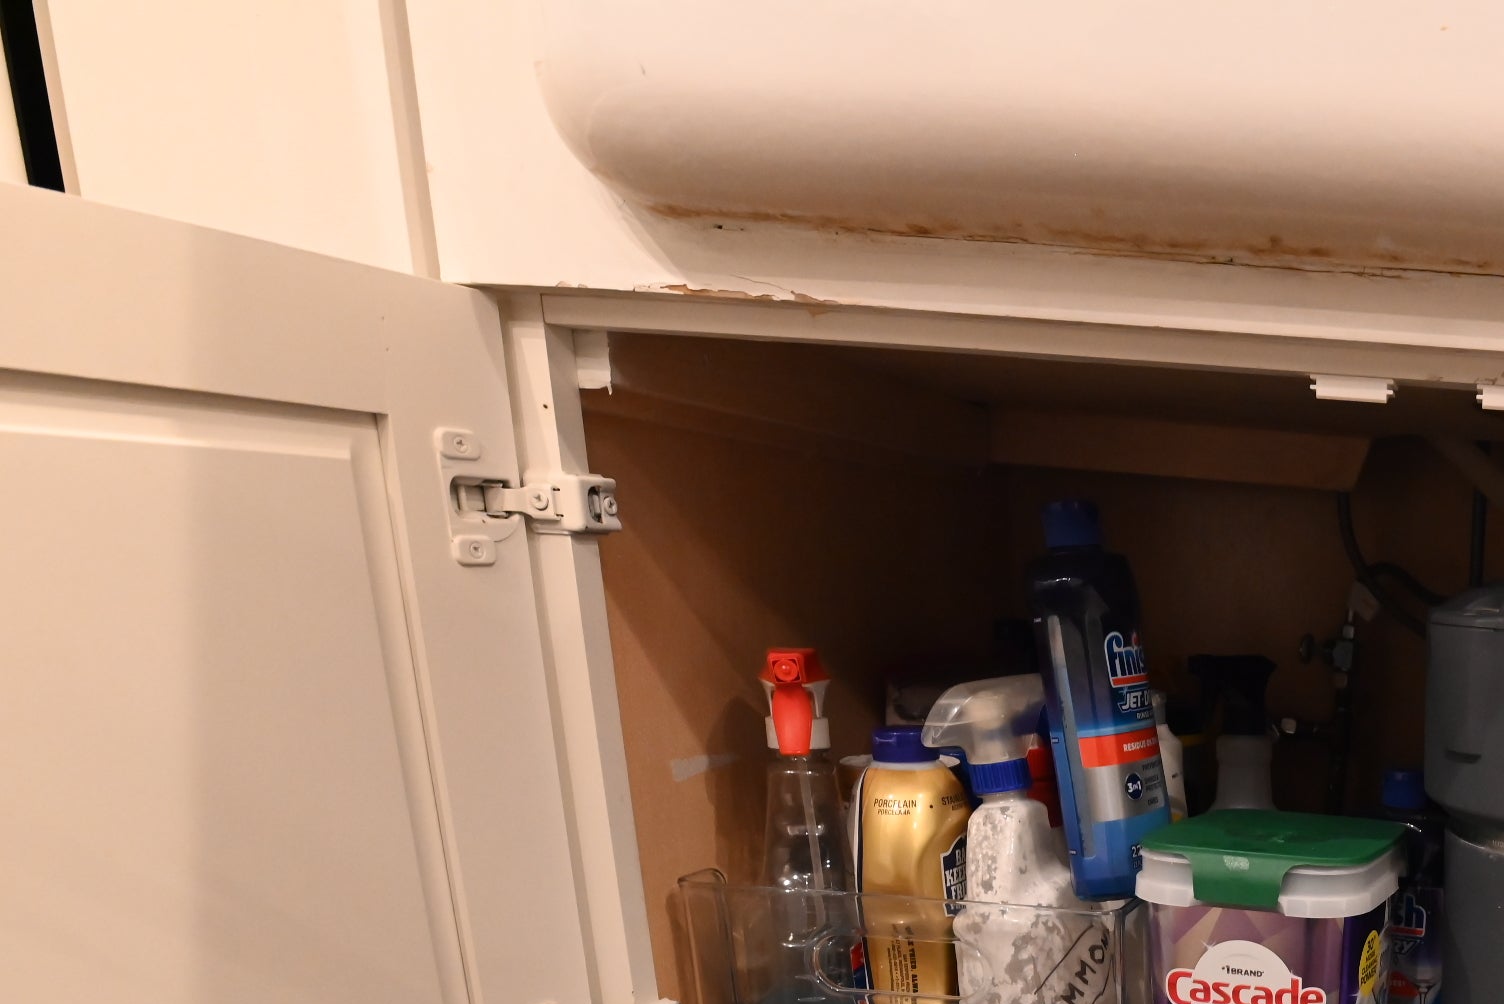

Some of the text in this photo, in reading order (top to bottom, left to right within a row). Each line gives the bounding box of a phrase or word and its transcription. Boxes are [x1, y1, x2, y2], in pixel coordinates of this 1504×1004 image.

[1104, 631, 1148, 679] fini
[1120, 690, 1151, 711] JET-D
[874, 798, 917, 808] PORCELAIN
[955, 848, 967, 866] BA
